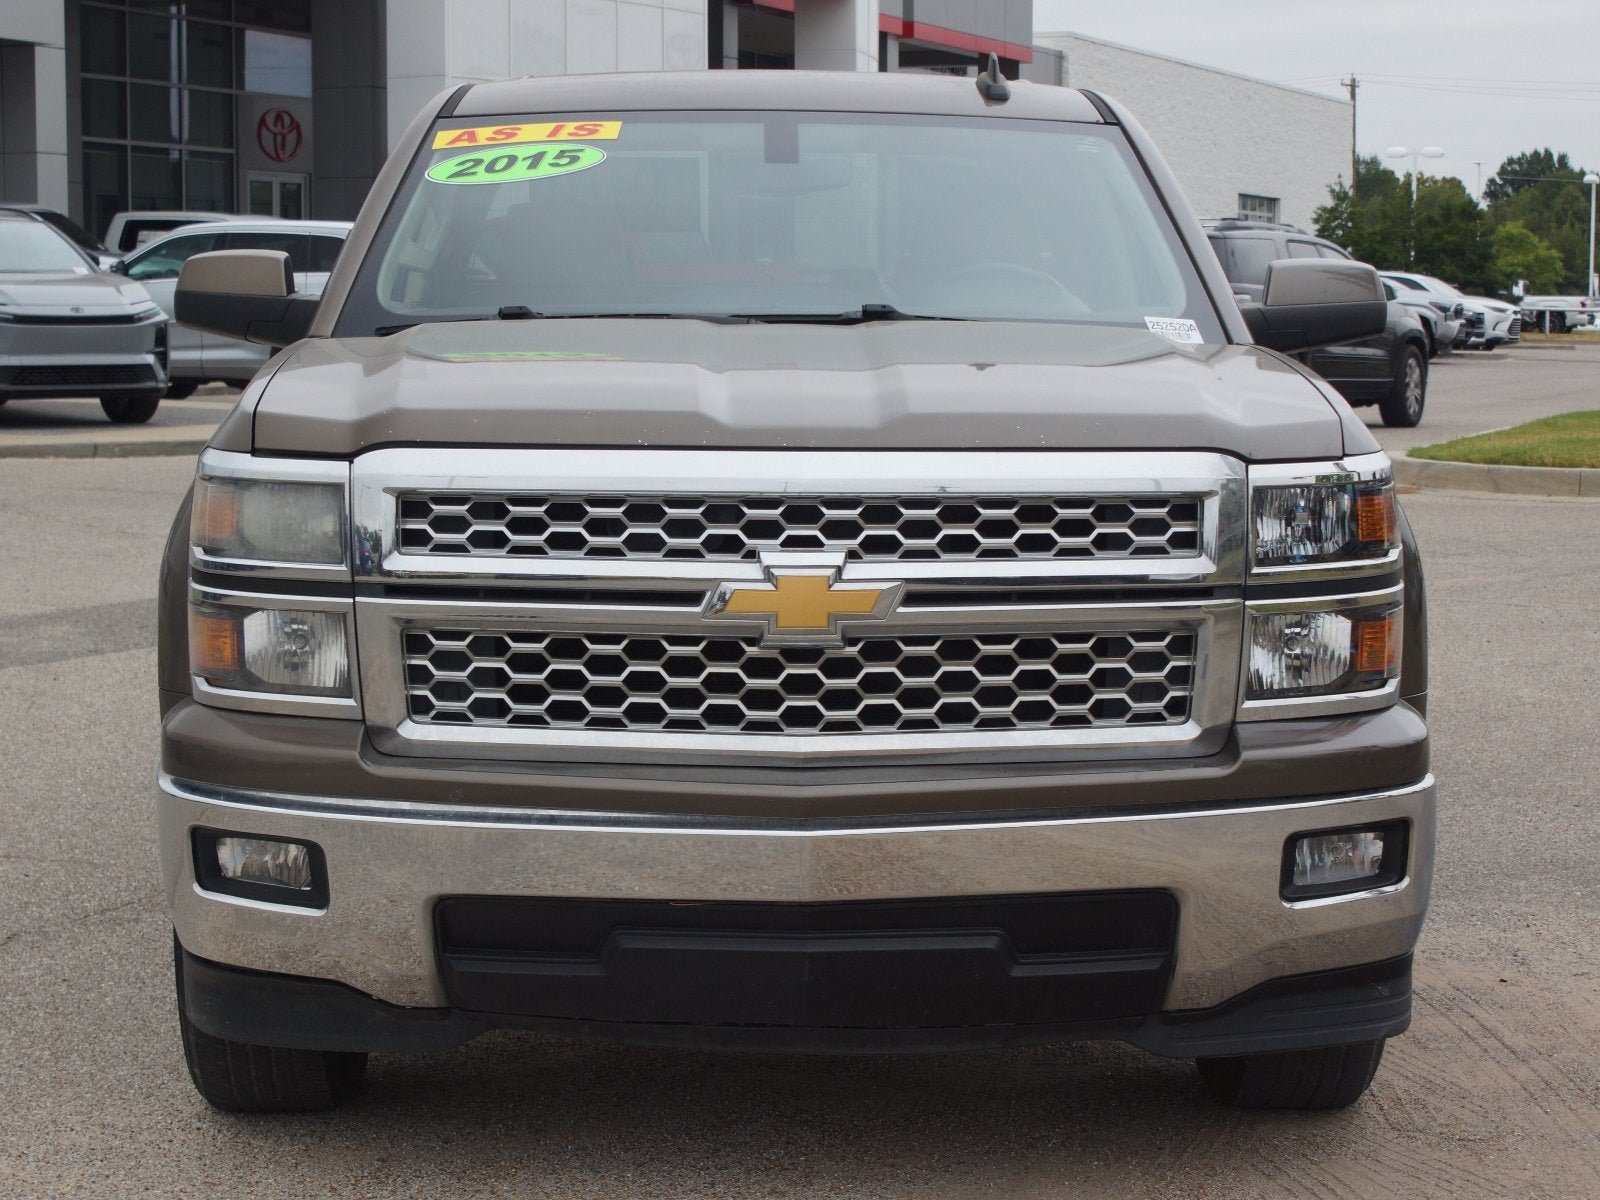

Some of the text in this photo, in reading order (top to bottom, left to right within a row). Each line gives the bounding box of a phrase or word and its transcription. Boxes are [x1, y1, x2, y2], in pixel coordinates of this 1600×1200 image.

[445, 123, 603, 145] AS IS
[445, 148, 585, 180] 2015
